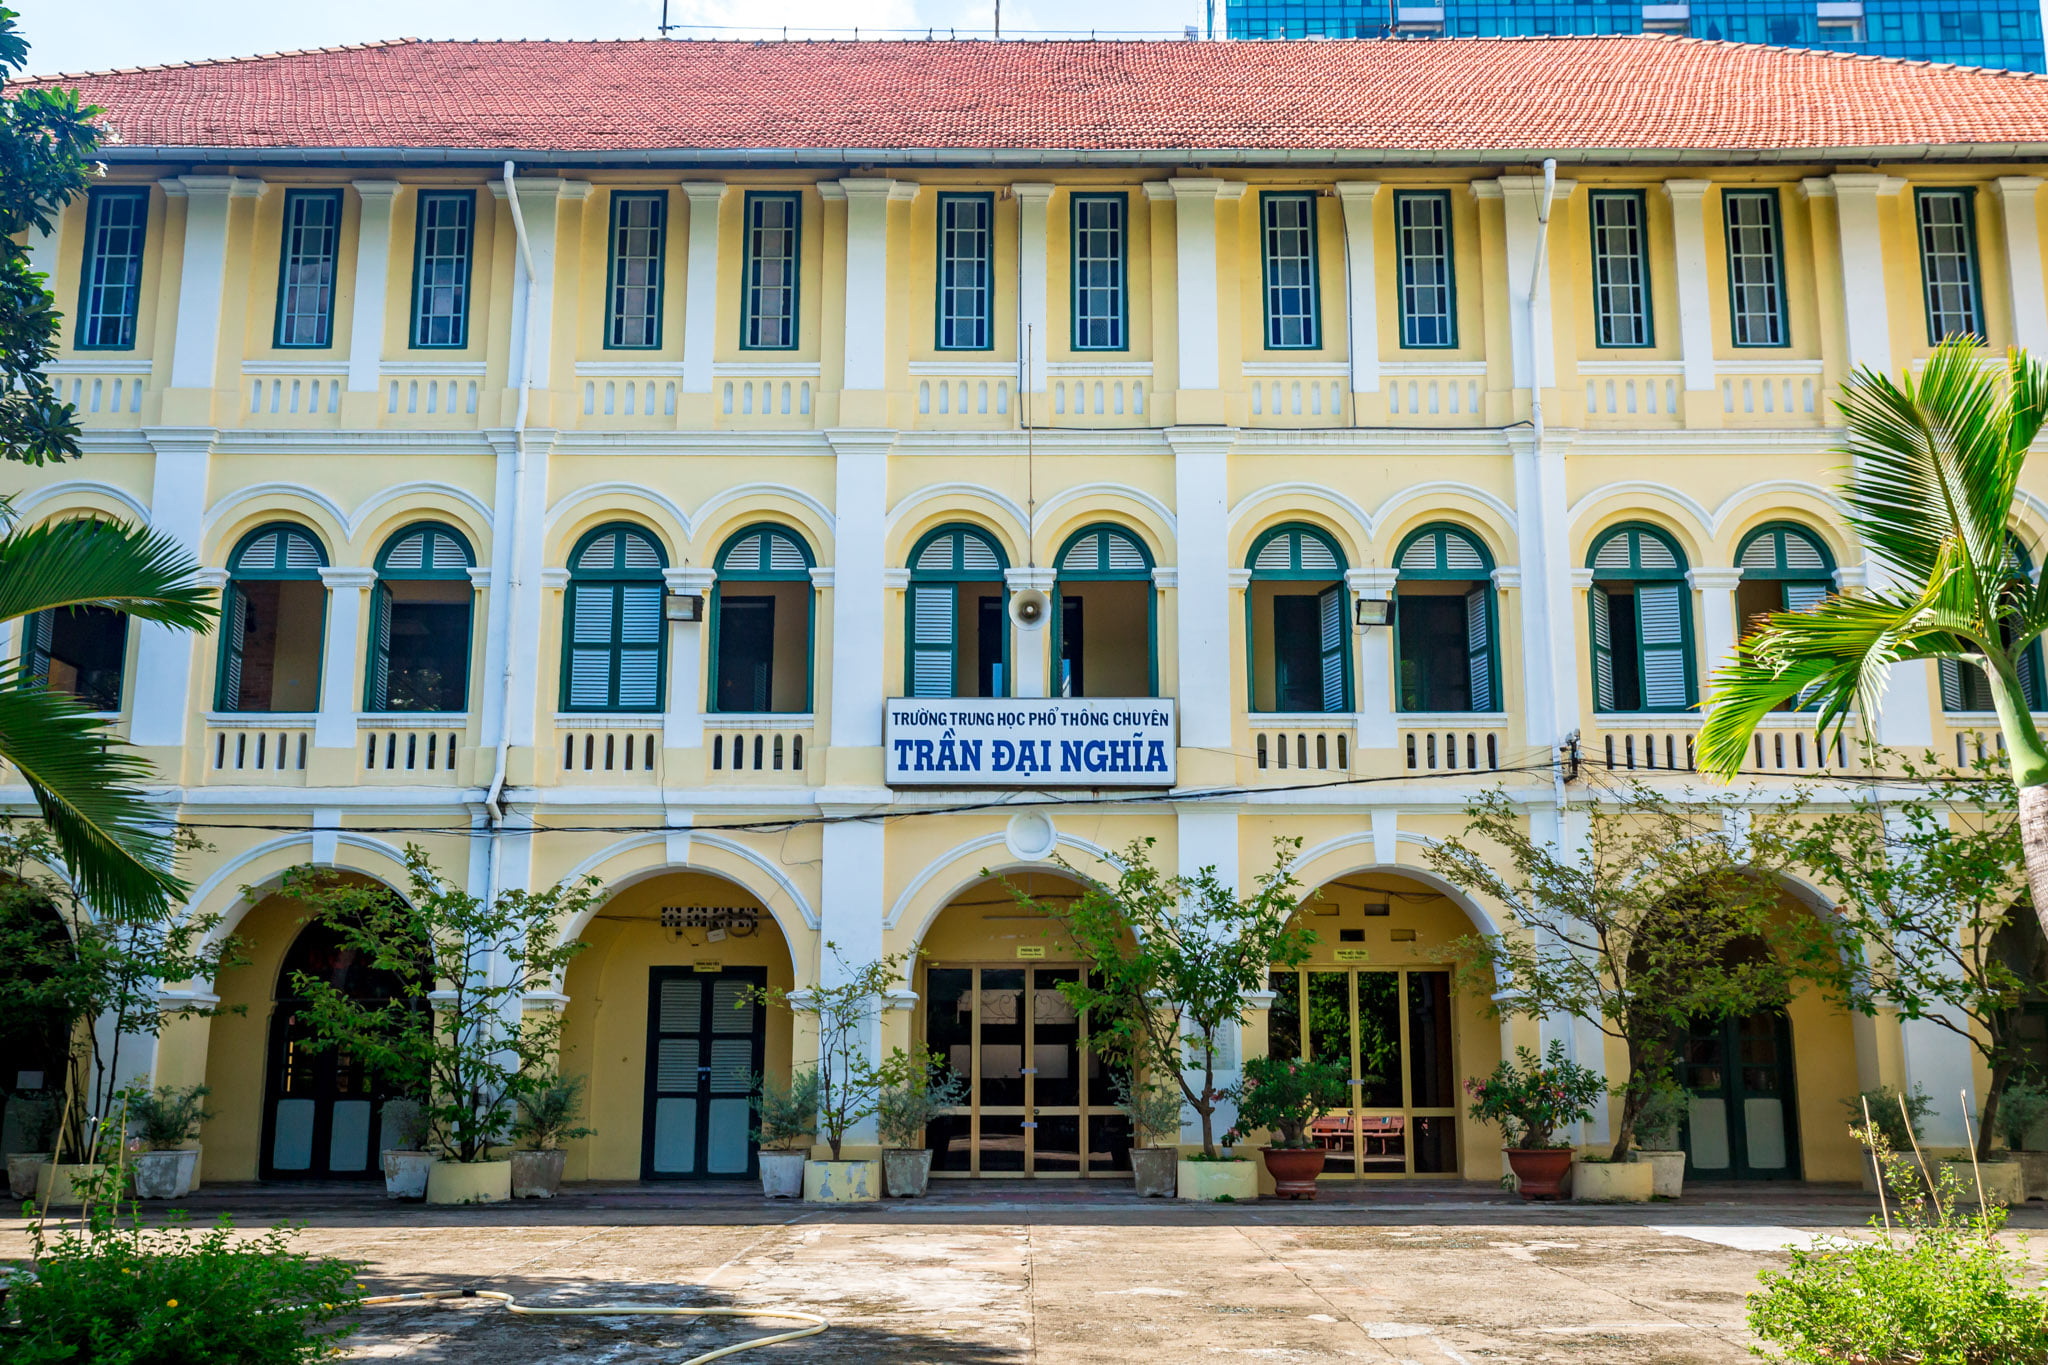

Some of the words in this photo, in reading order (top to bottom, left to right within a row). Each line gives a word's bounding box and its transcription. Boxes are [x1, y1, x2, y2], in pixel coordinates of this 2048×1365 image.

[892, 707, 947, 726] TRƯỜNG
[949, 712, 995, 726] TRUNG
[997, 712, 1025, 729] HỌC
[1028, 707, 1059, 726] PHỔ
[1060, 708, 1109, 726] THÔNG
[1113, 709, 1169, 726] CHUYÊN
[894, 728, 982, 771] TRẦN
[992, 739, 1051, 776] ĐẠI
[1060, 731, 1168, 772] NGHĨA
